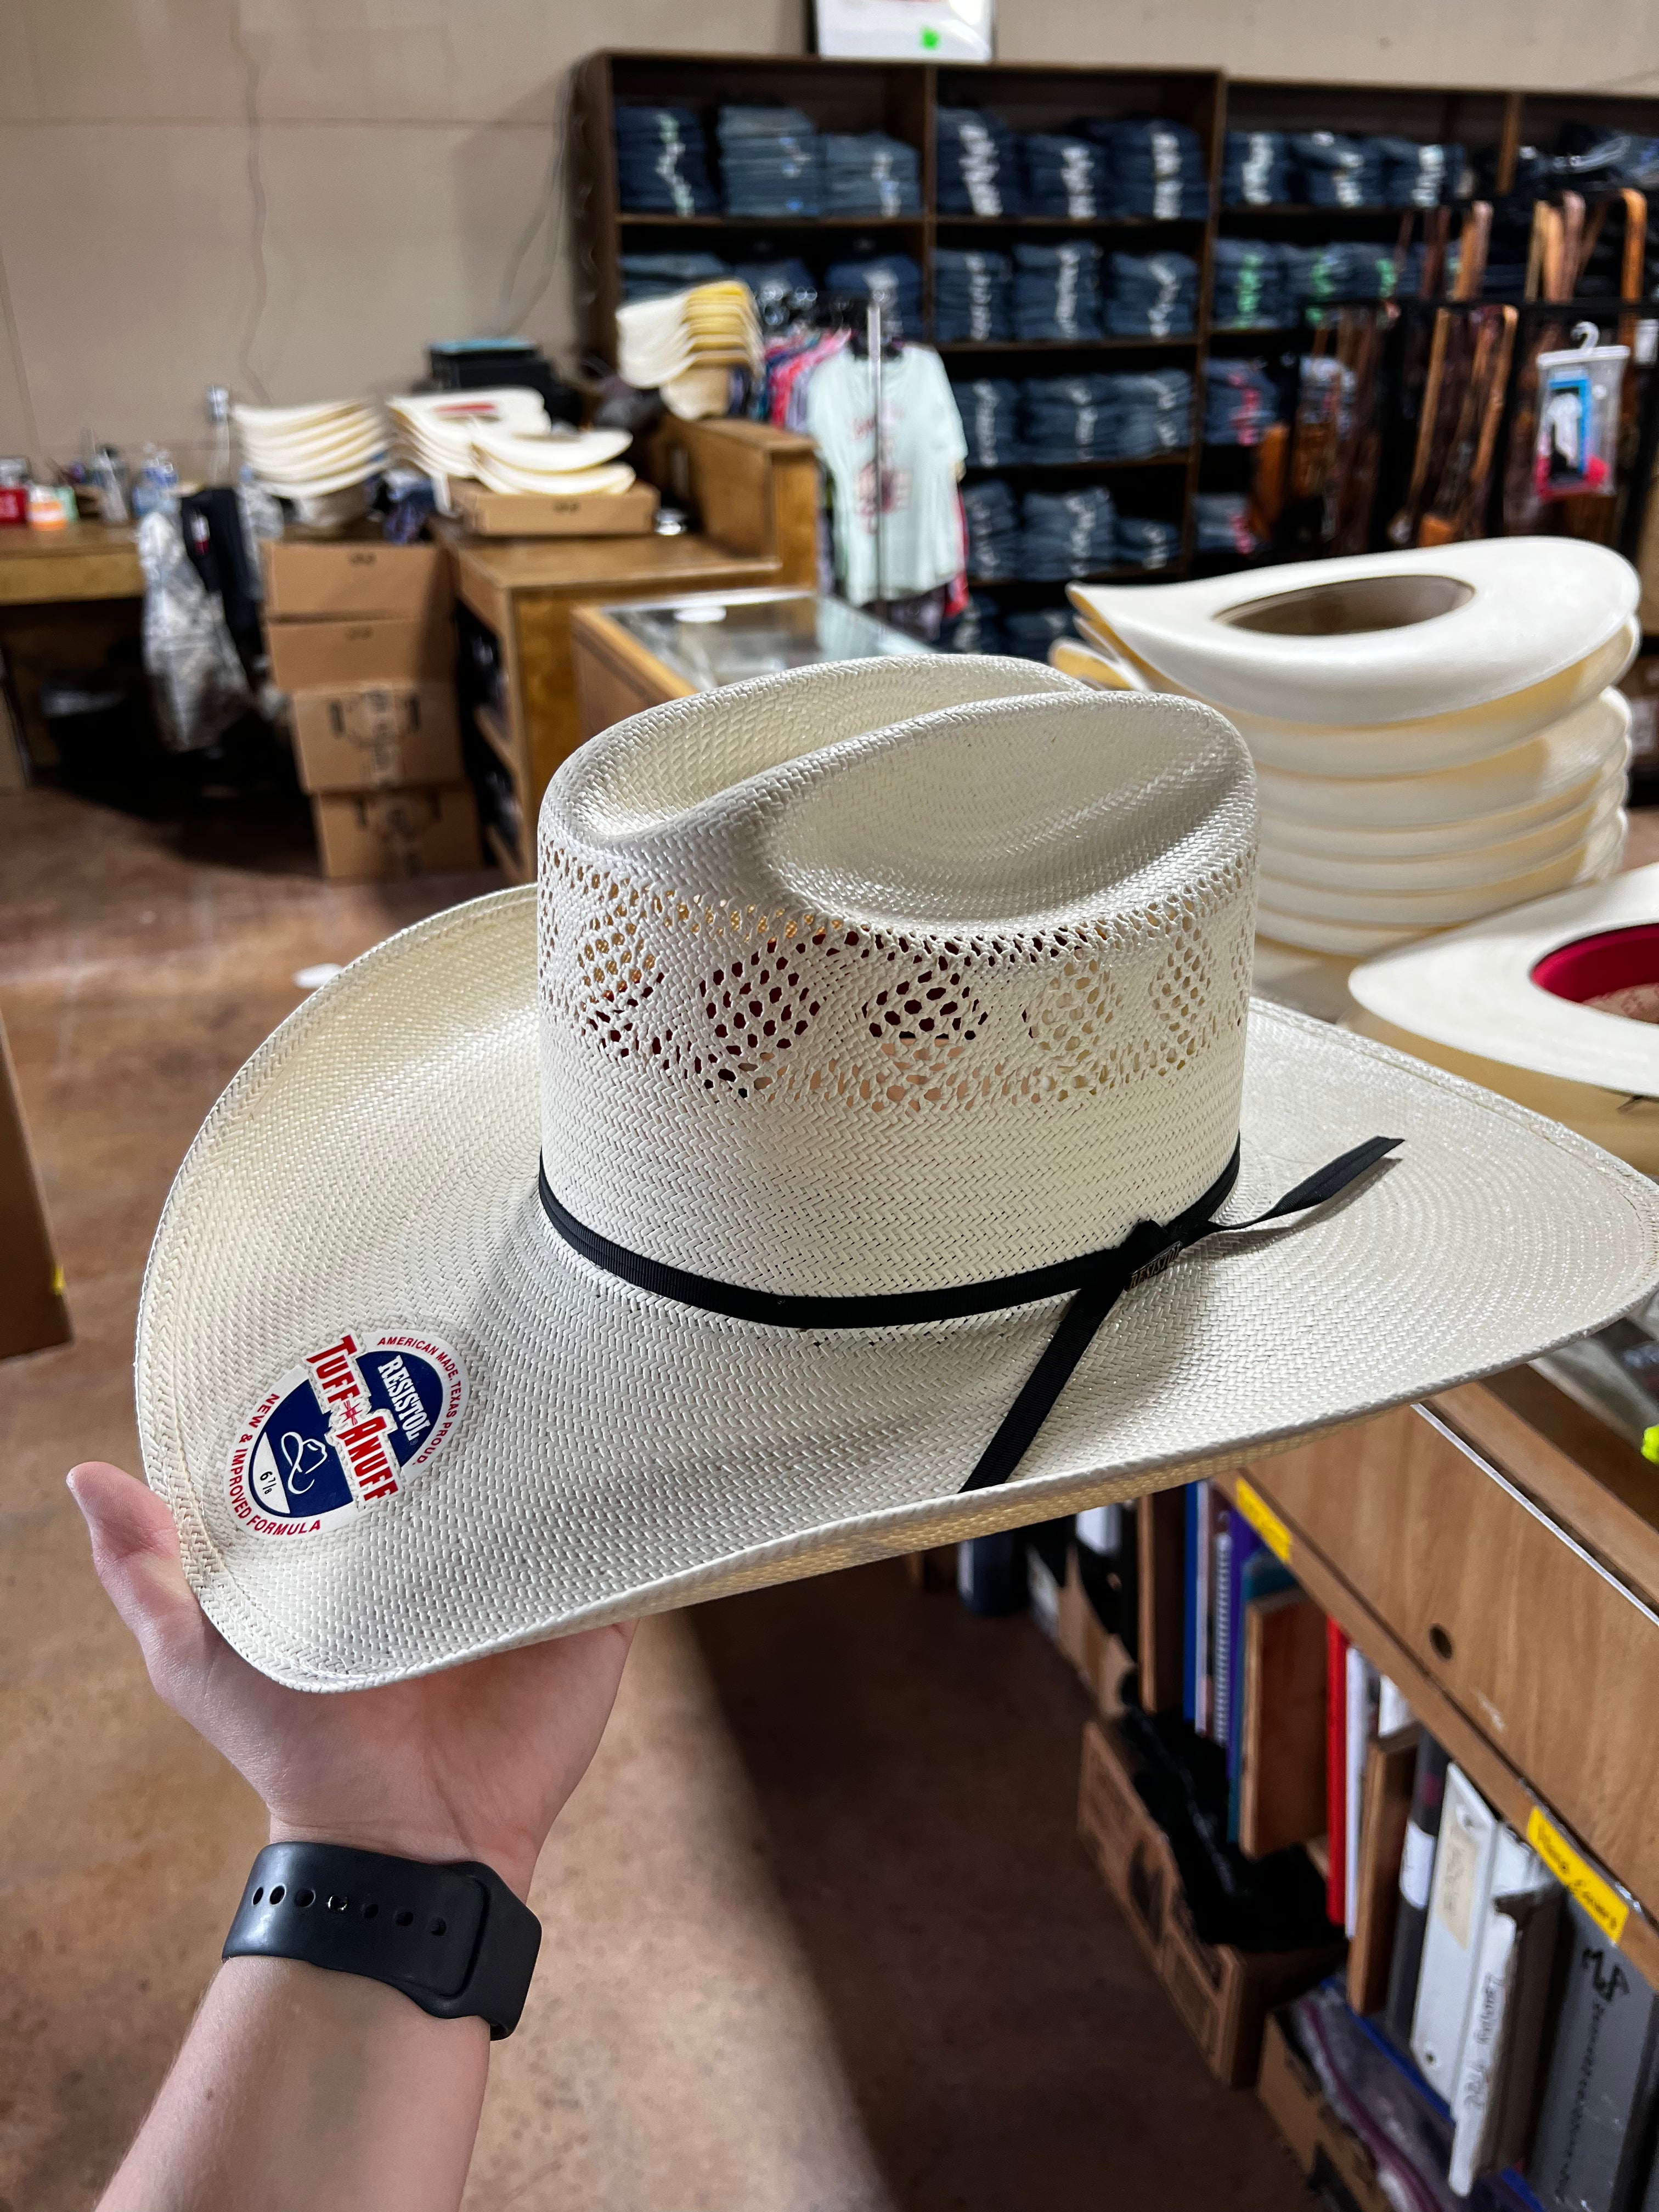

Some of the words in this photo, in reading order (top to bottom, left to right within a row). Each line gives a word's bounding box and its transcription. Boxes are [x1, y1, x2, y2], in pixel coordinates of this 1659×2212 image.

[249, 1393, 280, 1428] NEW
[377, 1336, 439, 1355] AMERICAN
[446, 1380, 461, 1418] TEXAS
[377, 1355, 431, 1441] RESISTOL
[239, 1434, 253, 1444] &
[306, 1334, 360, 1403] TUFF
[336, 1416, 398, 1501] ANUFF
[229, 1448, 252, 1519] IMPROVED
[246, 1514, 320, 1535] FORMULA
